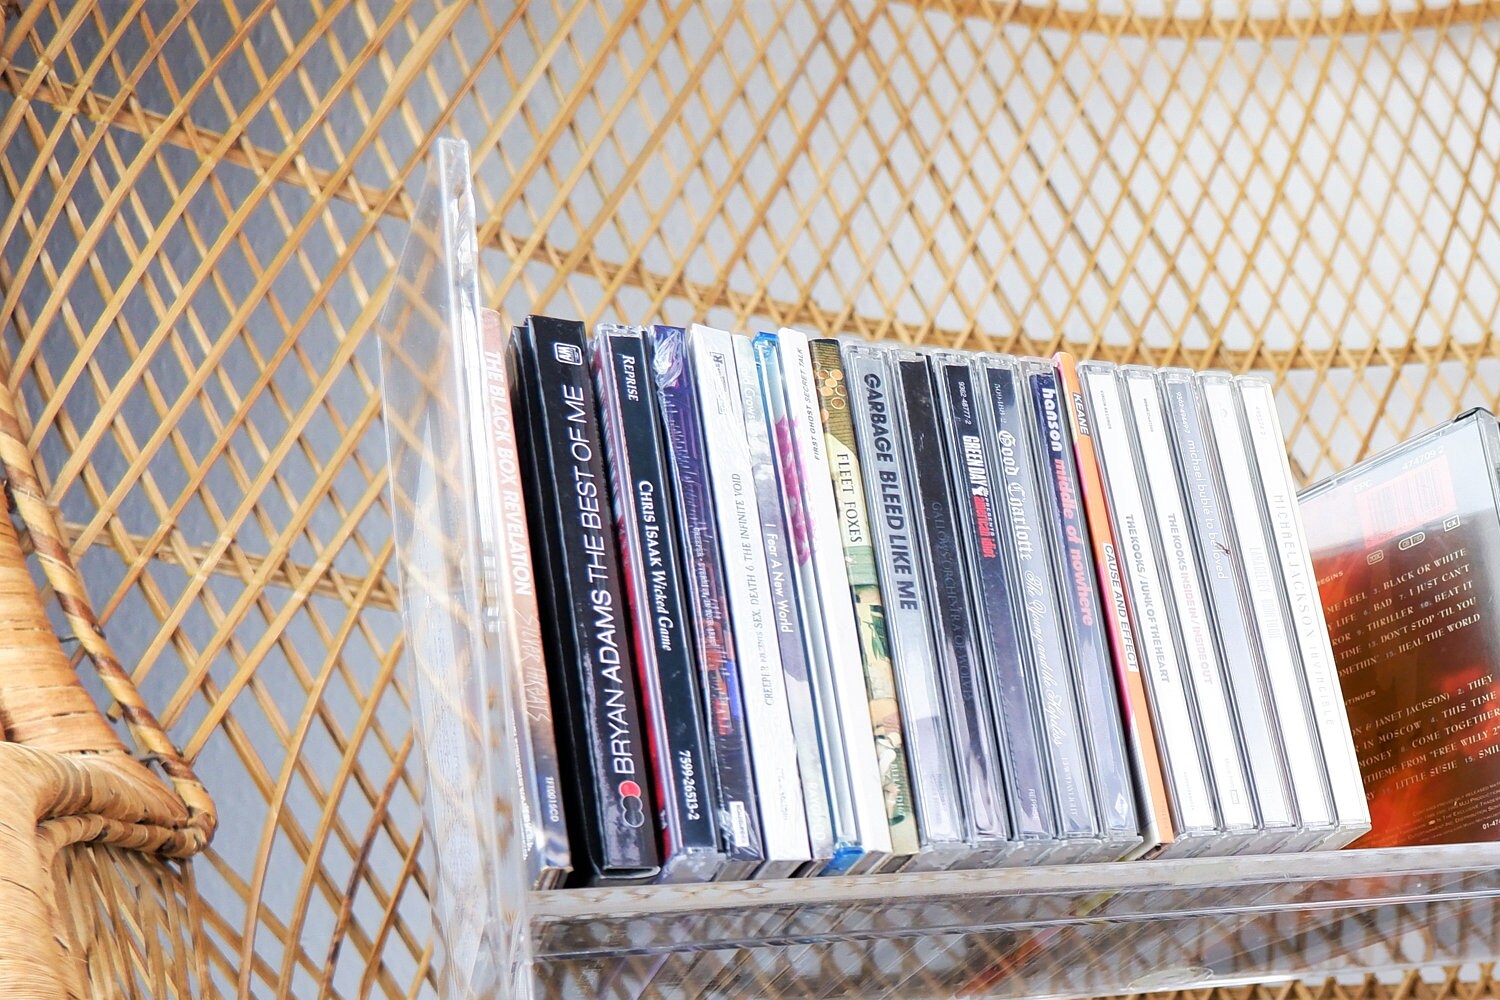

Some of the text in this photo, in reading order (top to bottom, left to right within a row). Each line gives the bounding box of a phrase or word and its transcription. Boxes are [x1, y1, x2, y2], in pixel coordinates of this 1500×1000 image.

[621, 352, 639, 402] REPRISE
[1073, 392, 1088, 435] KEANE
[484, 350, 531, 595] THE BLACK BOX REVELATION
[963, 434, 986, 486] GREEN DAY
[998, 429, 1020, 475] Good
[836, 453, 861, 542] FLEET FOXES
[863, 373, 917, 611] GARBAGE BLEED LIKE ME
[1041, 387, 1096, 625] hanson middle of nowhere
[1186, 439, 1204, 481] michael
[1196, 484, 1212, 513] bublé
[1204, 518, 1215, 528] to
[766, 533, 780, 557] Fear
[974, 495, 996, 558] american idiot
[1007, 481, 1036, 559] Charlotte
[562, 383, 633, 775] BRYAN ADAMS THE BEST OF ME
[639, 479, 675, 651] CHRIS ISAAK Wicked Game
[770, 559, 782, 568] A
[772, 571, 786, 597] New
[1384, 548, 1467, 590] BLACK OR WHITE
[777, 600, 792, 633] World
[1104, 544, 1136, 669] CAUSE AND EFFECT
[1367, 580, 1473, 632] THRILLER BEAT IT
[1411, 614, 1435, 631] STOP
[1456, 597, 1476, 612] YOU
[1399, 613, 1481, 653] HEAL THE WORLD
[1412, 708, 1500, 748] COME TOGETHER
[678, 749, 698, 820] 7599-26513-2
[1395, 773, 1427, 790] LITTLE
[1430, 760, 1458, 777] SUSIE
